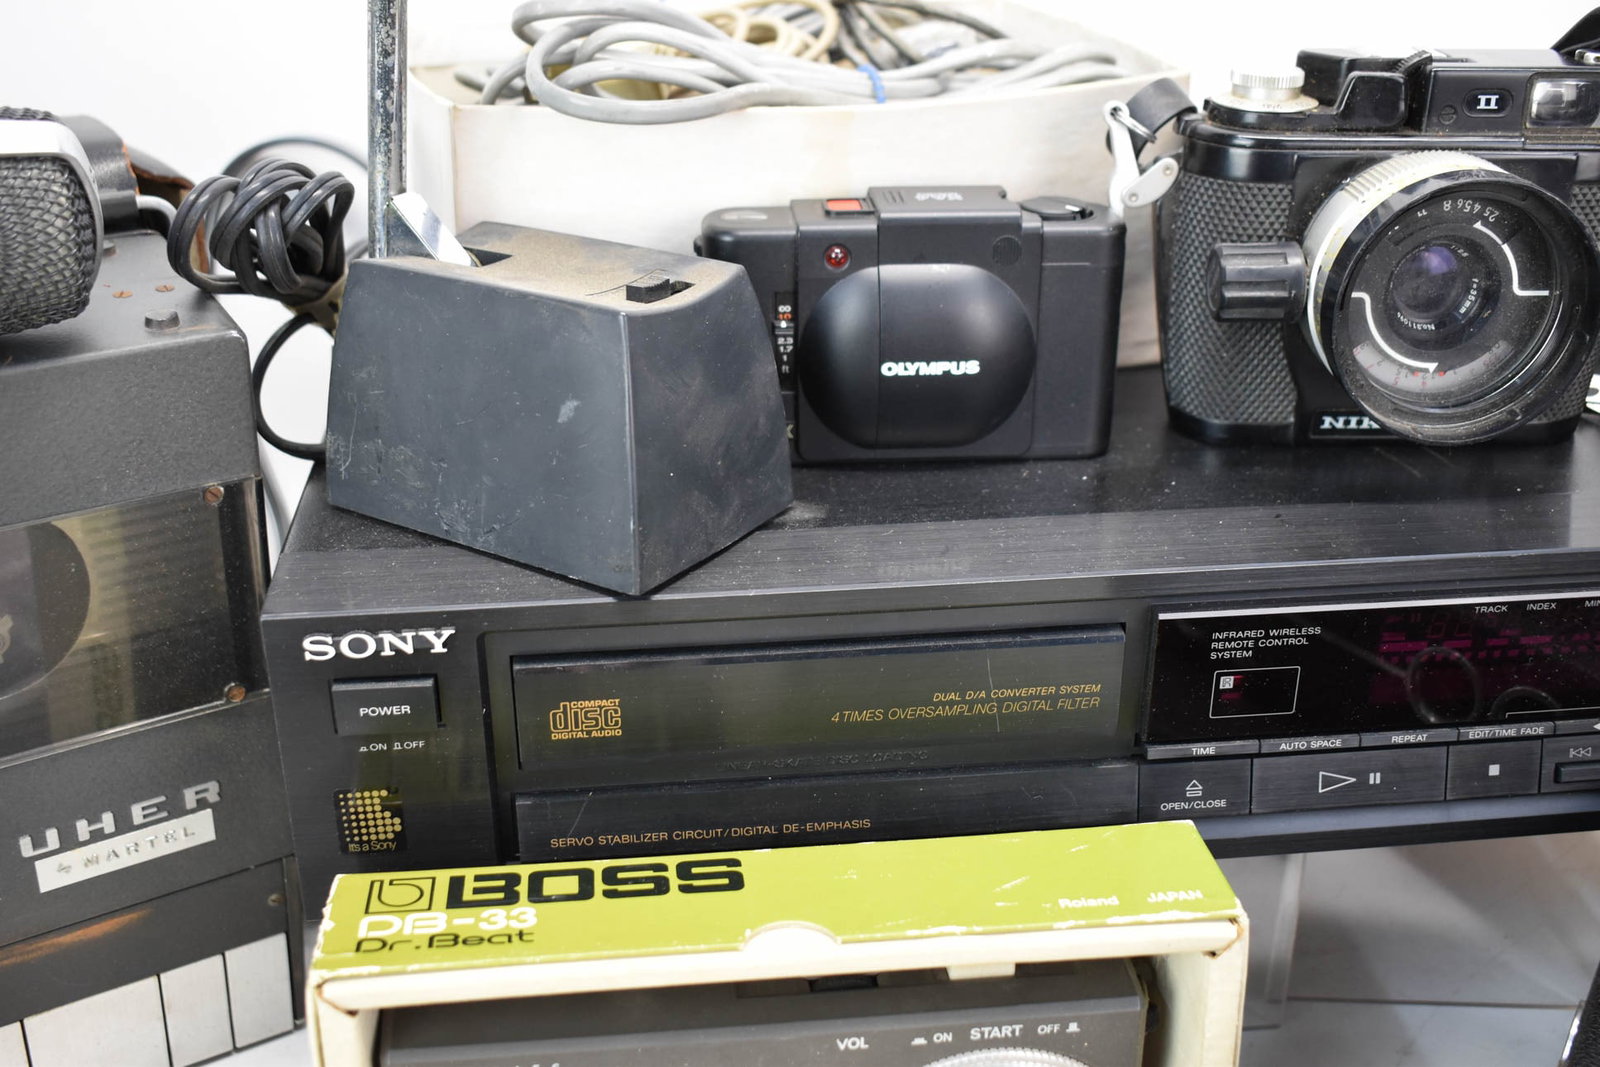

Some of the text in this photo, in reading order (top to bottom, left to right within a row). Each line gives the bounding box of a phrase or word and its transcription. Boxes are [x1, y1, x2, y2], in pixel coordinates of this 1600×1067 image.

[1477, 95, 1499, 109] II
[1443, 200, 1452, 211] 8
[1457, 199, 1473, 212] 5.6
[1473, 203, 1481, 214] 4
[881, 360, 980, 377] OLYMPUS
[1320, 416, 1382, 429] NIK
[1475, 605, 1508, 614] TRACK
[1526, 602, 1557, 611] INDEX
[1212, 627, 1322, 640] INFRARED WIRELESS
[302, 628, 455, 660] SONY
[1211, 638, 1309, 650] REMOTE CONTROL
[1210, 650, 1253, 660] SYSTEM
[933, 684, 1101, 702] DUAL D/A CONVERTER SYSTEM
[571, 699, 620, 708] COMPACT
[831, 696, 1100, 723] 4 TIMES OVERSAMPLING DIGITAL FILTER
[359, 705, 411, 716] POWER
[551, 729, 622, 740] DIGITAL AUDIO
[1391, 734, 1428, 744] REPEAT
[1468, 726, 1545, 739] EDIT/TIME FADE
[369, 741, 426, 751] ON OFF
[1192, 746, 1216, 756] TIME
[1279, 739, 1342, 751] AUTO SPACE
[1160, 799, 1227, 811] OPEN/CLOSE
[18, 779, 221, 858] UHER
[550, 837, 594, 848] SERVO
[598, 833, 668, 845] STABILIZER
[783, 819, 871, 834] DE-EMPHASIS
[371, 840, 397, 850] Sony
[445, 858, 746, 910] BOSS
[1058, 895, 1120, 909] Roland
[1146, 889, 1204, 904] JAPAN
[357, 907, 538, 938] DB-33
[970, 1025, 1024, 1041] START
[1037, 1023, 1061, 1036] OFF
[933, 1031, 953, 1043] ON
[836, 1037, 869, 1051] VOL
